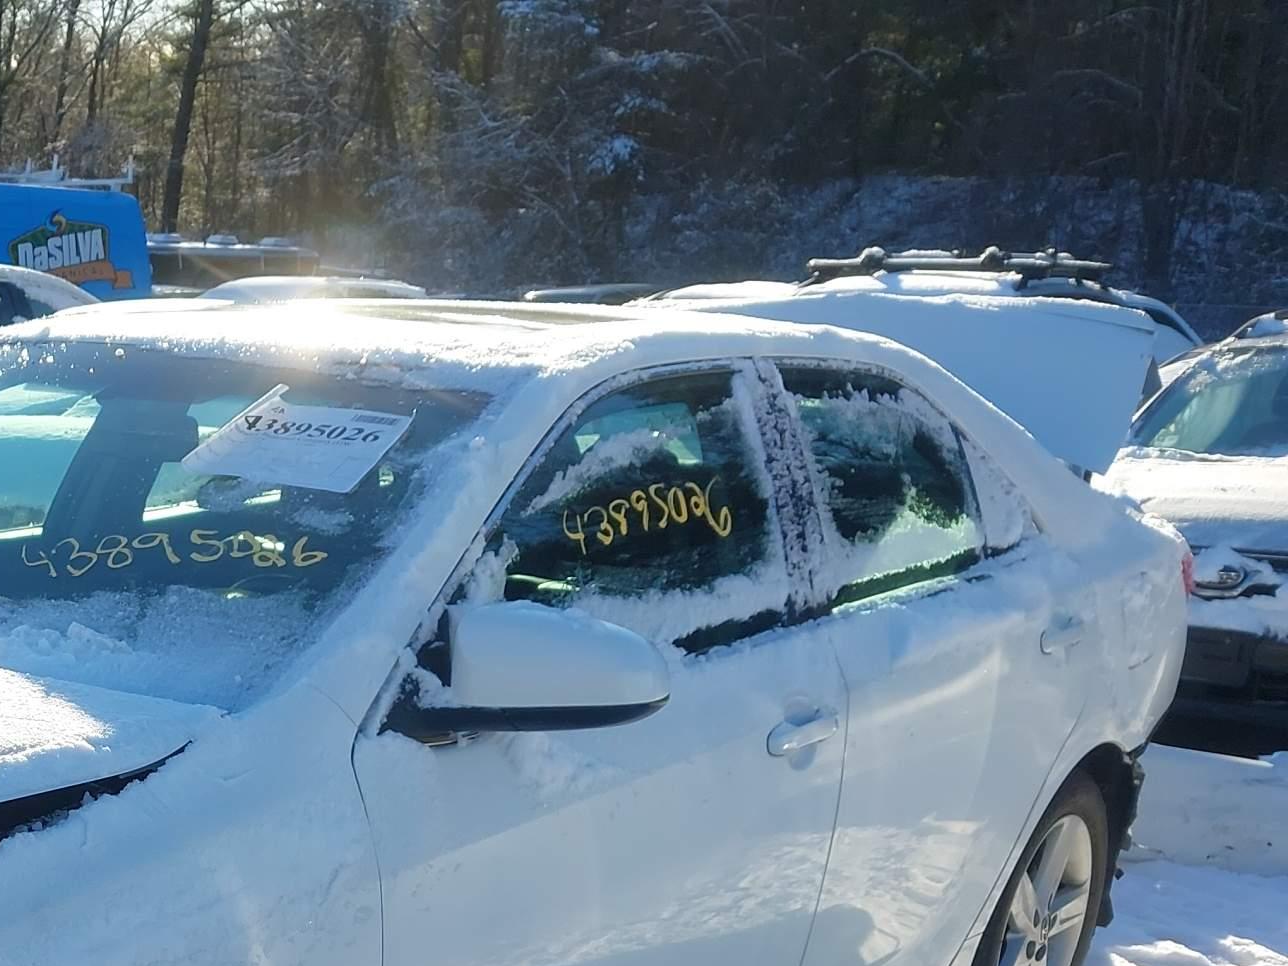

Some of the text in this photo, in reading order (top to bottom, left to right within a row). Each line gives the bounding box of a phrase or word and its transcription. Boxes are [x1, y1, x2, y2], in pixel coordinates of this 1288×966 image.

[244, 415, 385, 443] 43895026
[564, 475, 732, 555] 43895026
[21, 529, 328, 577] 43895026
